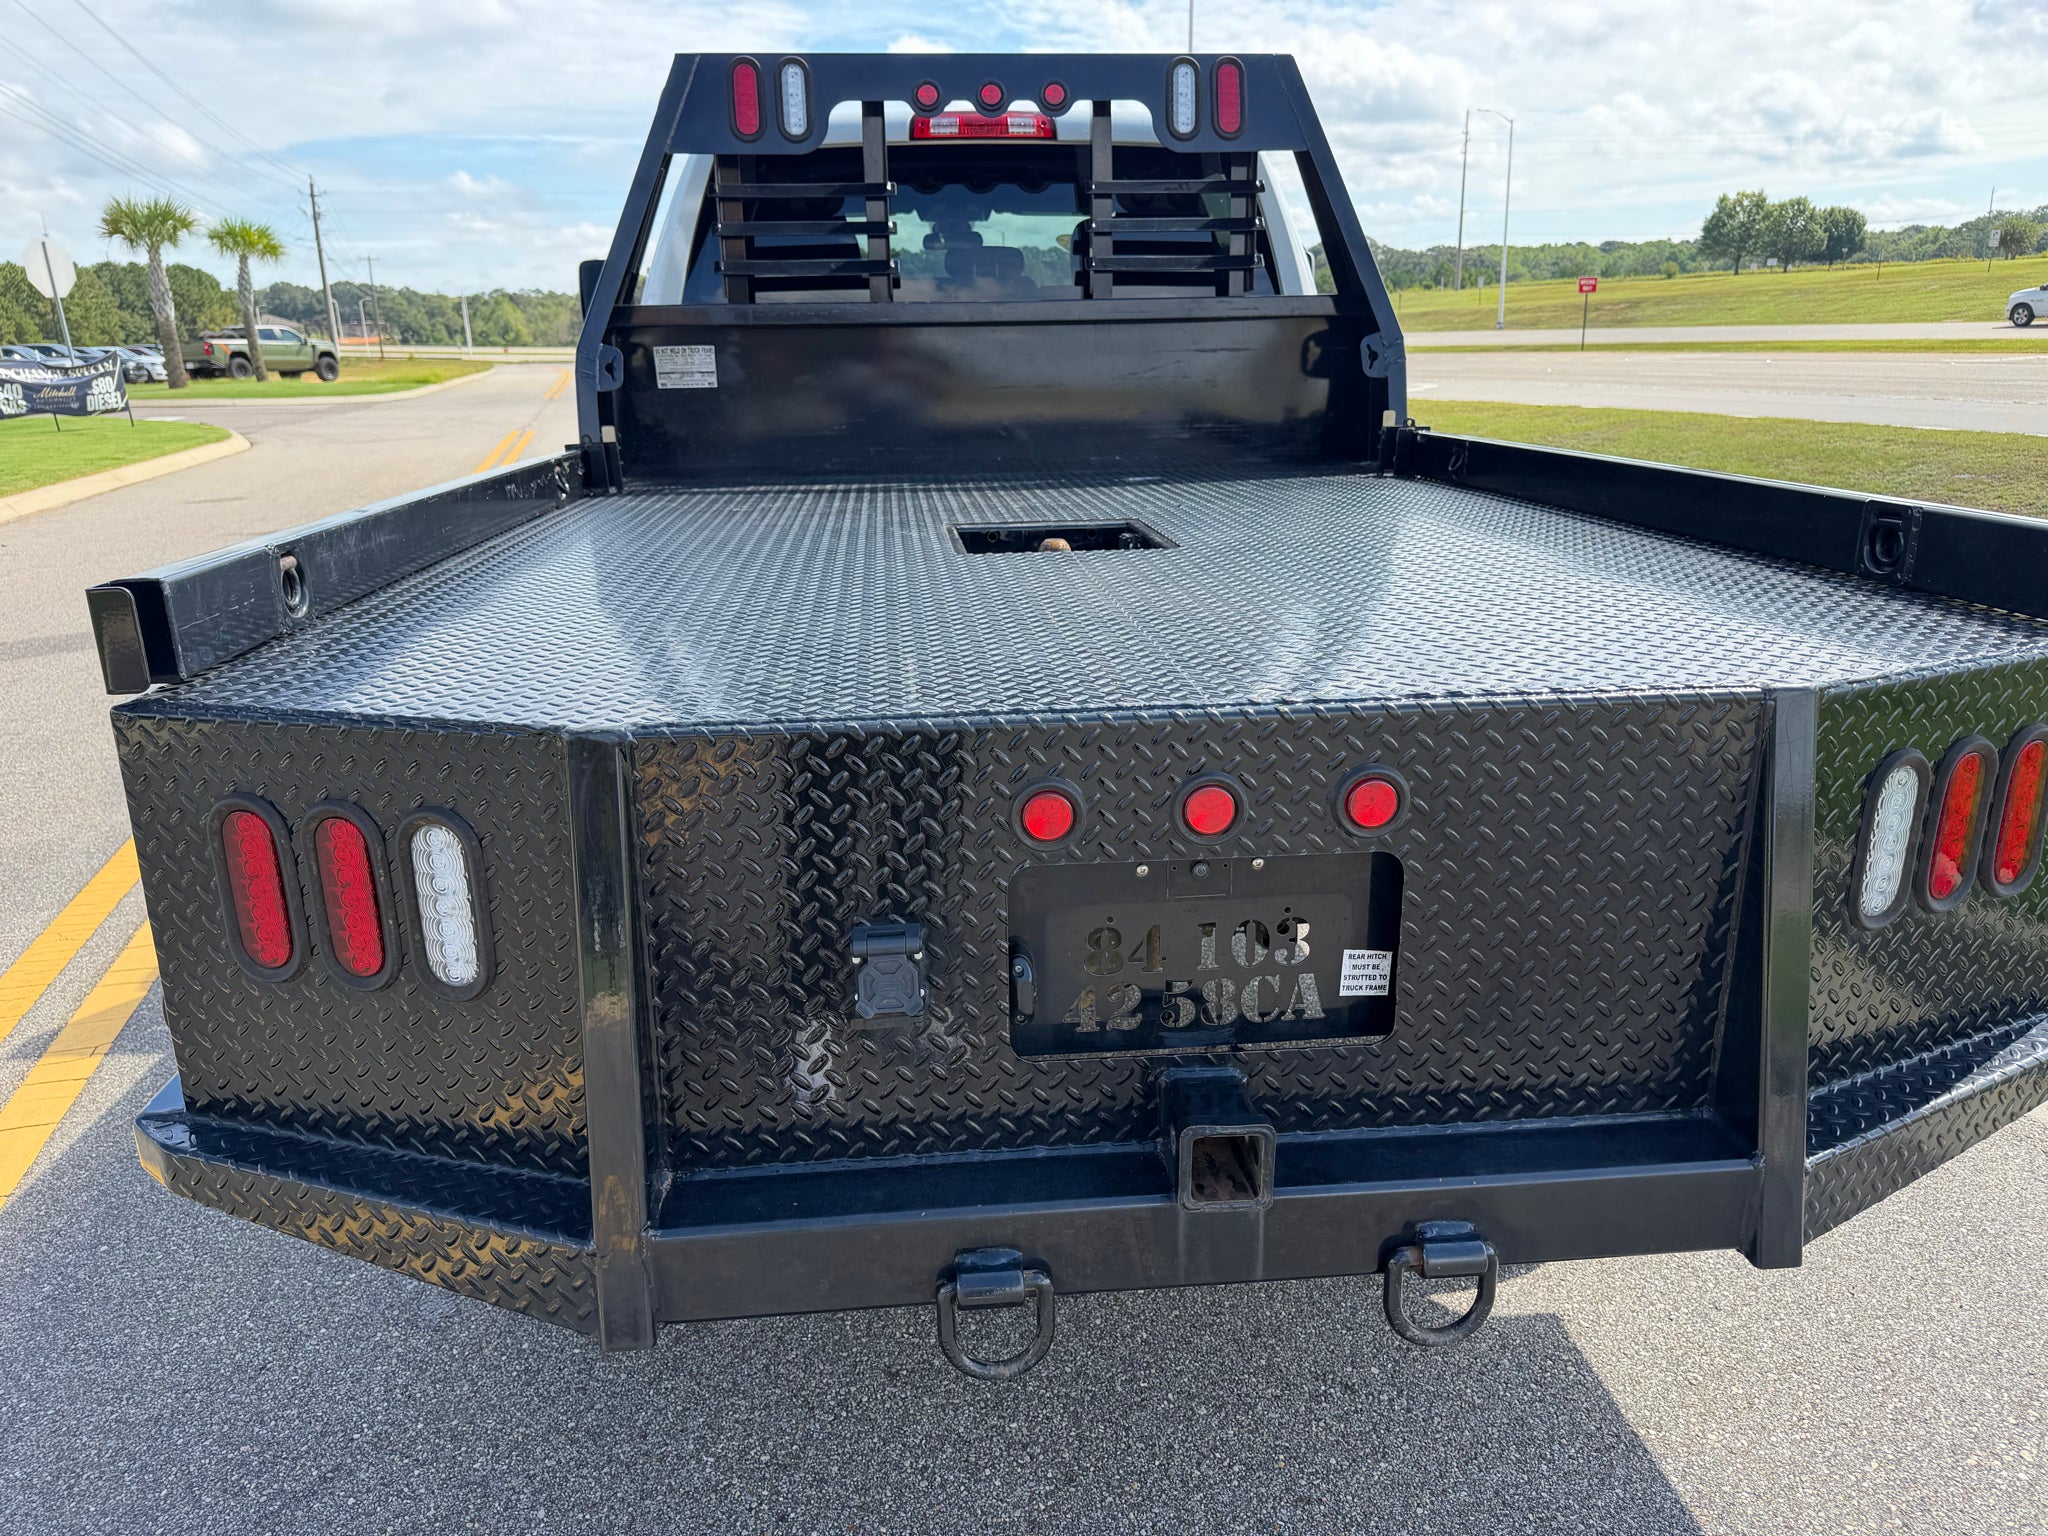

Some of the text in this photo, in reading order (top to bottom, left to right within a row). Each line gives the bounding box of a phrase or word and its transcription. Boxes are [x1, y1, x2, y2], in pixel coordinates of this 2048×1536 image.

[86, 391, 125, 411] DIESEL
[1083, 916, 1311, 977] 84 103
[1352, 963, 1370, 971] MUST
